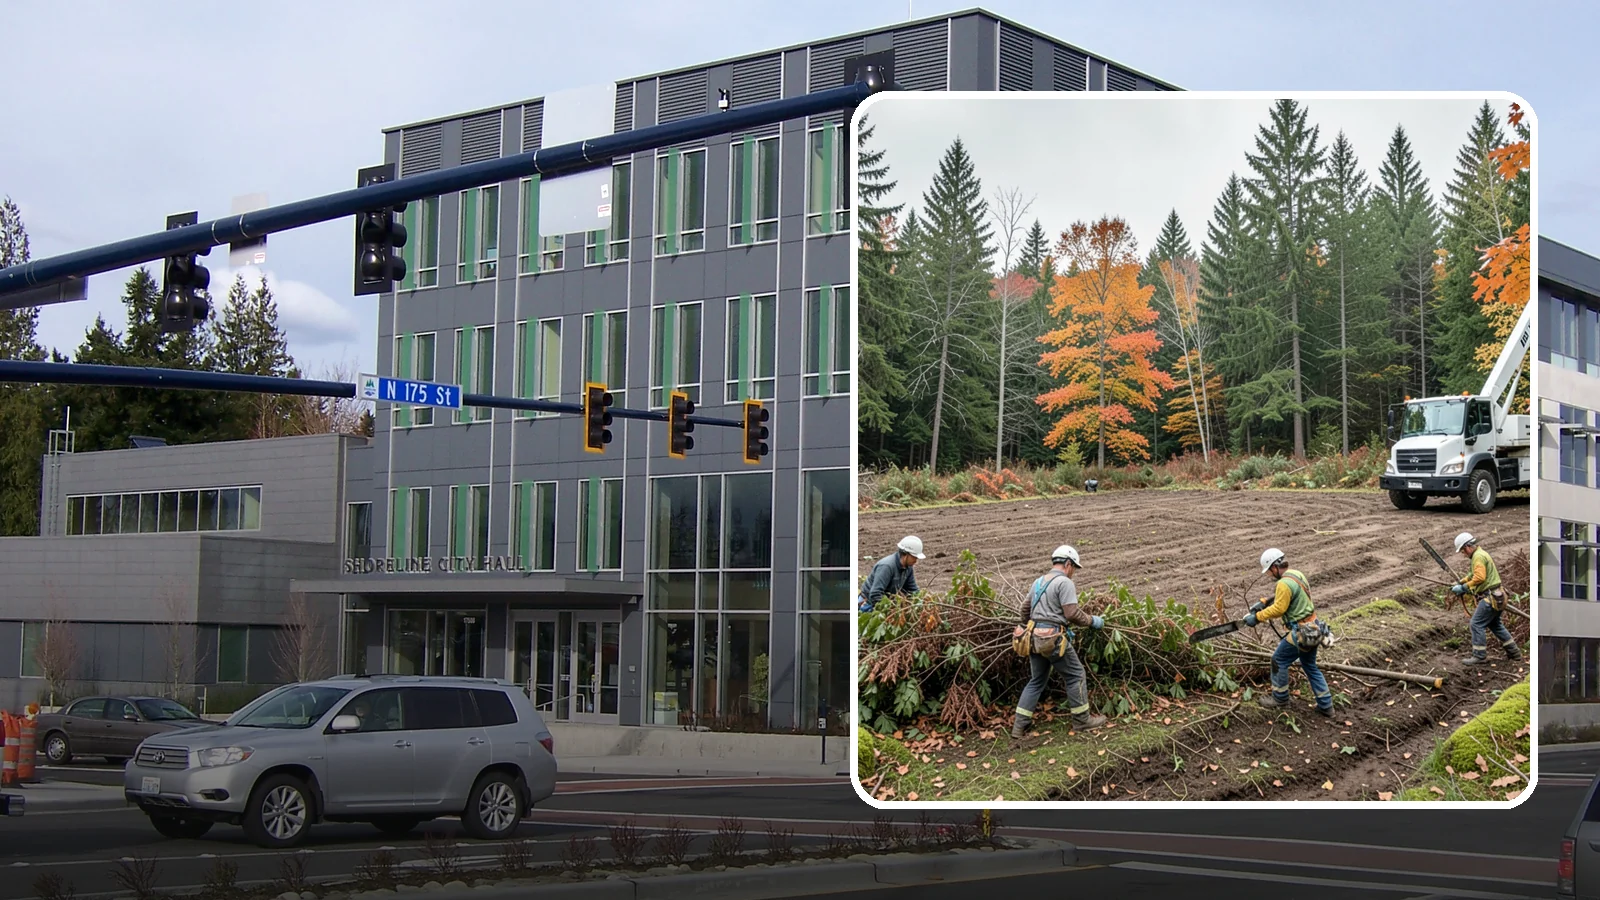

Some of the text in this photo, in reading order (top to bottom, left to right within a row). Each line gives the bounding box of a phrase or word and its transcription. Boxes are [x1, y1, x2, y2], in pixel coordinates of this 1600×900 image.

[387, 381, 451, 406] N 175 St
[344, 555, 526, 575] SHORELINE CITY HALL
